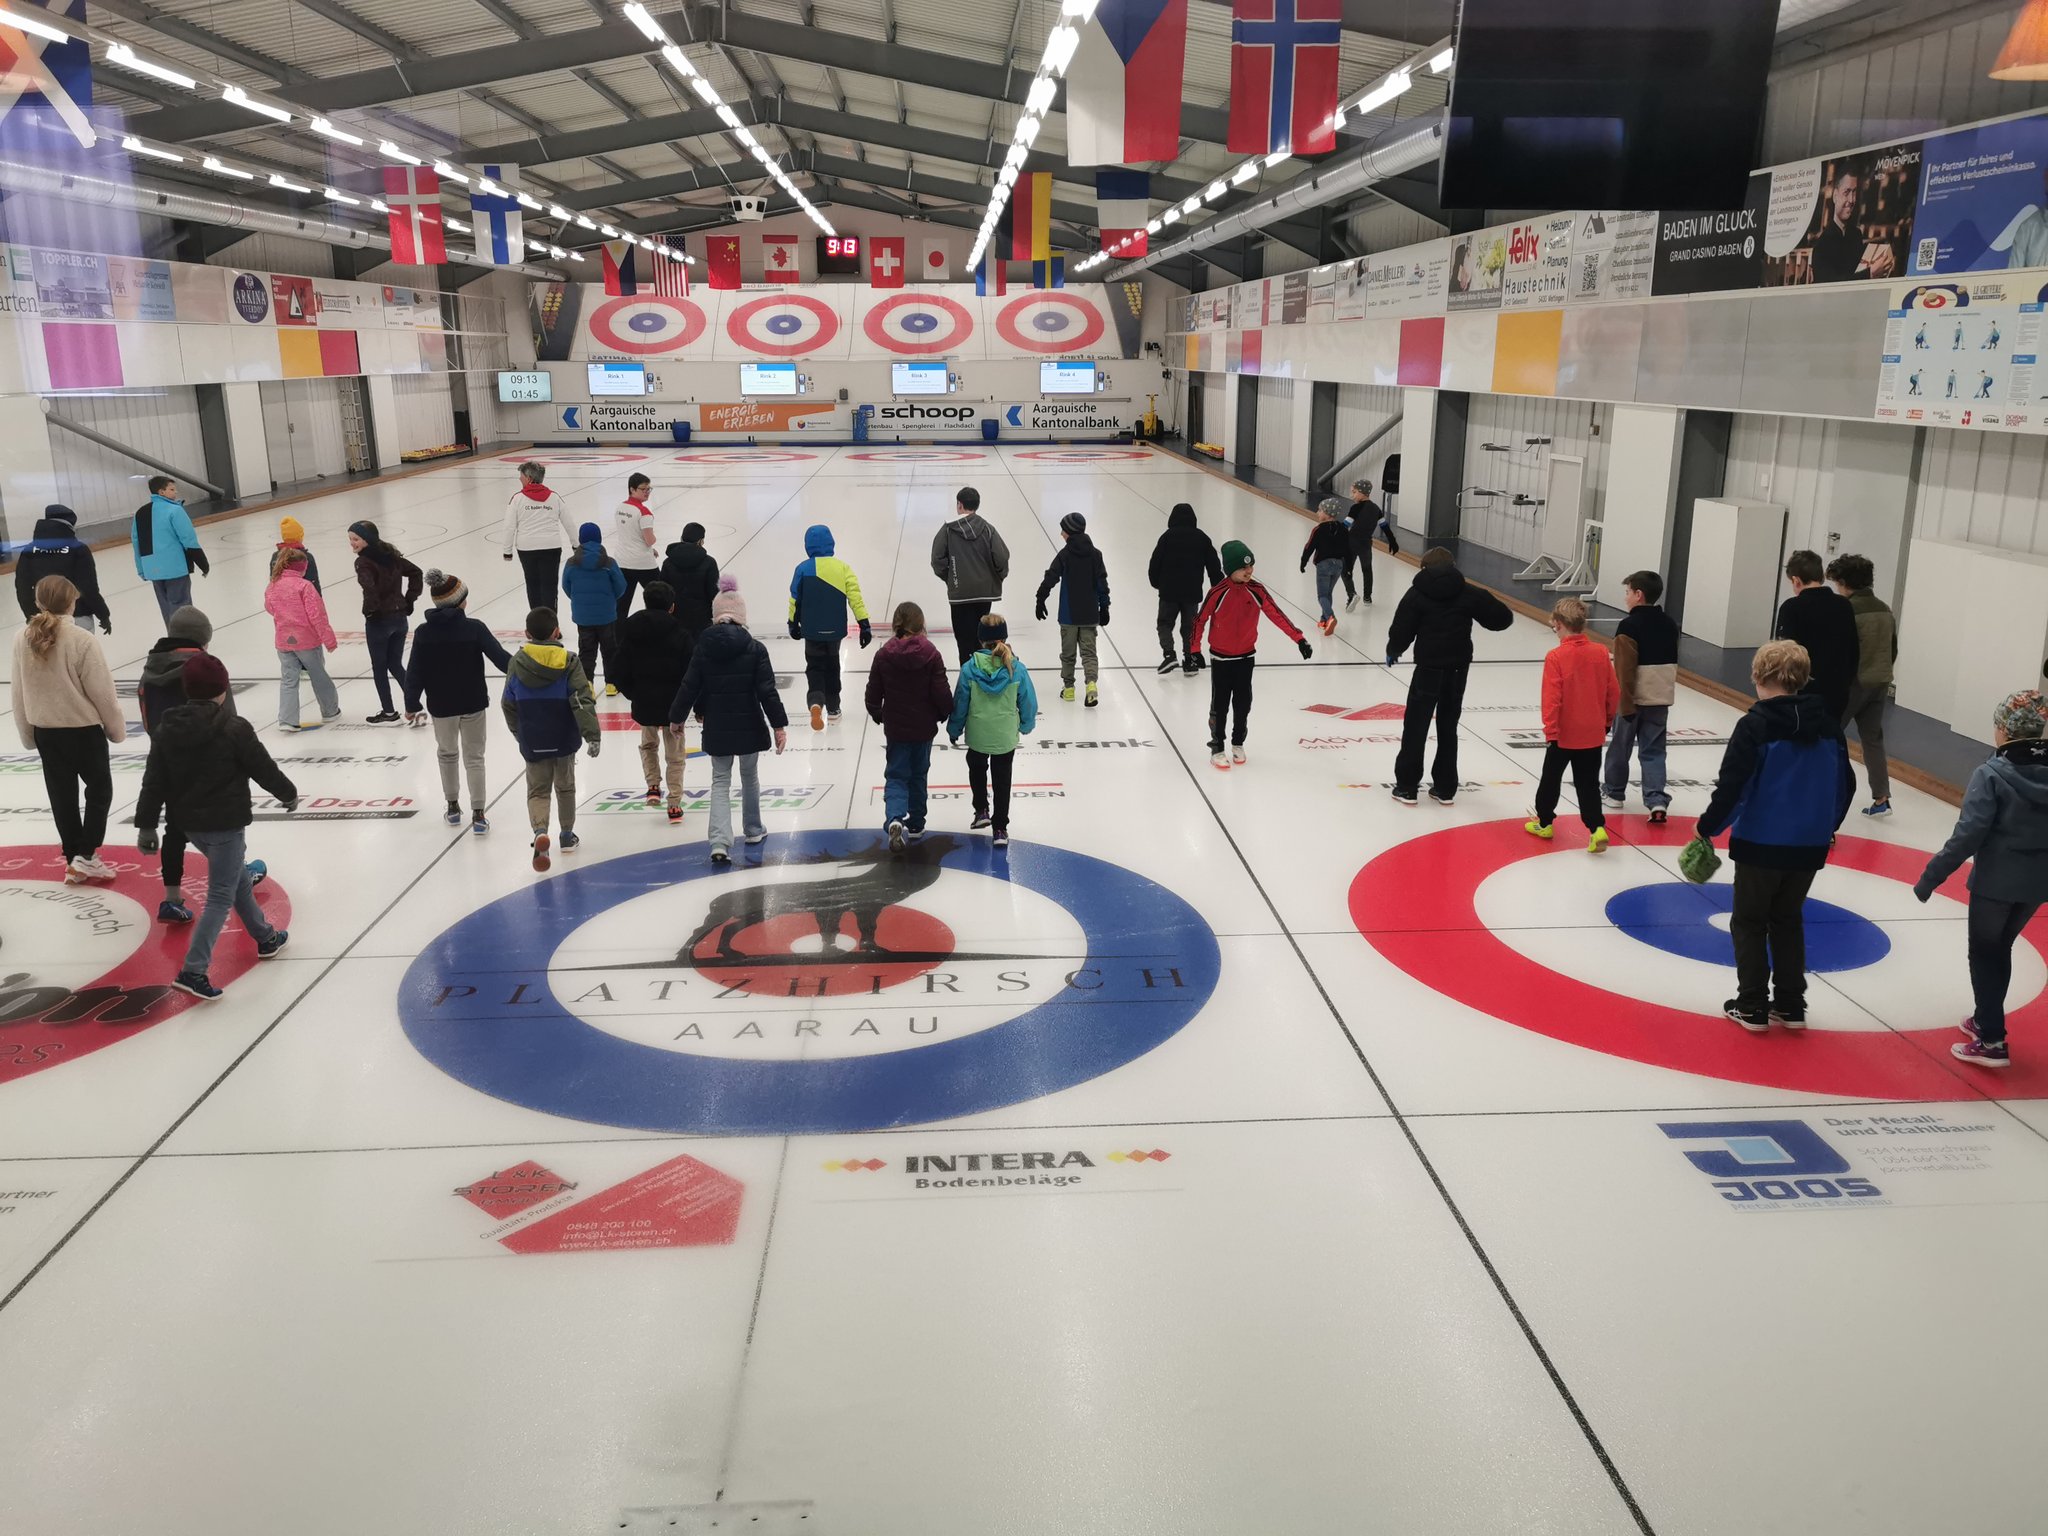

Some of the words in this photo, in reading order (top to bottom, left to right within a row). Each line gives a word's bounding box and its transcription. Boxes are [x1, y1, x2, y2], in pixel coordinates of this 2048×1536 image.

[1875, 152, 1920, 171] MÖVENPICK
[1941, 160, 1967, 171] Partner
[1967, 157, 1978, 167] für
[1999, 150, 2014, 161] und
[1929, 173, 1962, 186] effektives
[1550, 218, 1572, 232] Heizung
[1663, 218, 1698, 241] BADEN
[1699, 215, 1713, 235] IM
[1669, 249, 1691, 262] GRAND
[1691, 245, 1717, 260] CASINO
[1717, 242, 1742, 256] BADEN
[41, 251, 99, 269] TOPPLER.CH
[1546, 255, 1569, 268] Planung
[1504, 272, 1567, 295] Haustechnik
[510, 374, 538, 384] 09:13
[511, 389, 539, 399] 01:45
[891, 394, 897, 402] 3
[590, 405, 656, 418] Aargauische
[709, 404, 758, 421] ENERGIE
[881, 404, 975, 421] schoop
[1033, 403, 1097, 416] Aargauische
[723, 410, 775, 431] ERLEBEN
[1032, 416, 1120, 429] Kantonalbank
[1666, 727, 1717, 737] ach
[1037, 738, 1157, 749] frank
[1298, 735, 1468, 745] MÖVENC
[307, 796, 414, 809] Dach
[432, 967, 1190, 1007] PLATZHIRSCH
[673, 1016, 938, 1041] AARAU
[1824, 1117, 1863, 1127] Der
[1868, 1114, 1945, 1126] Metall-
[1837, 1125, 1878, 1137] und
[1881, 1123, 1996, 1135] Stahlbauer
[904, 1150, 1097, 1174] INTERA
[491, 1170, 501, 1180] L
[512, 1169, 527, 1179] &
[531, 1168, 552, 1178] K
[914, 1173, 1083, 1190] Bodenbeläge
[451, 1181, 579, 1197] STOREN
[1711, 1177, 1883, 1201] JOOS
[566, 1221, 598, 1231] 0848
